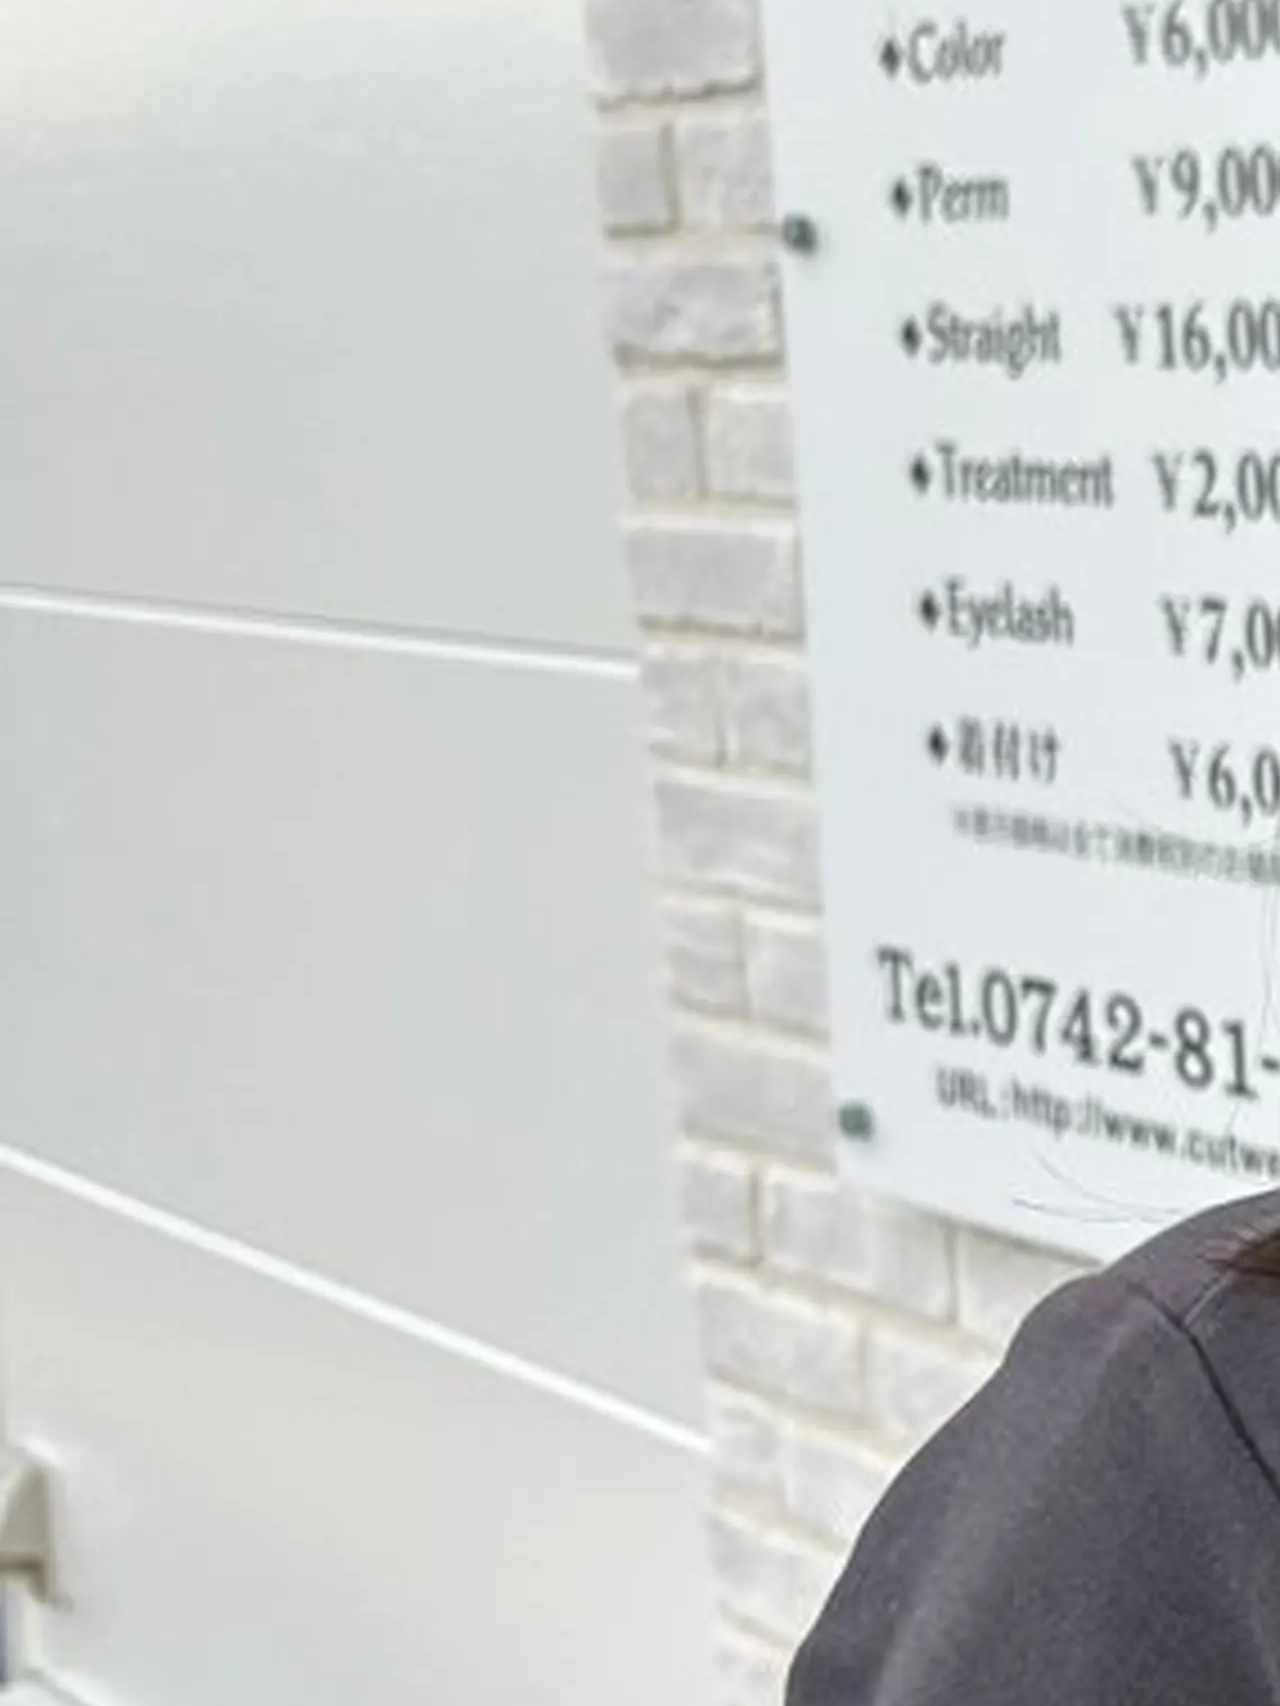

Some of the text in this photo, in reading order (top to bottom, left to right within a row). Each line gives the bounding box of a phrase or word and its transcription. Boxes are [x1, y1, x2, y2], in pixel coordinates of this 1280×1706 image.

[906, 21, 1005, 85] Color
[915, 162, 1010, 223] Perm
[925, 302, 1063, 381] Straight
[936, 440, 1115, 508] Treatment
[944, 576, 1075, 648] Eyelash
